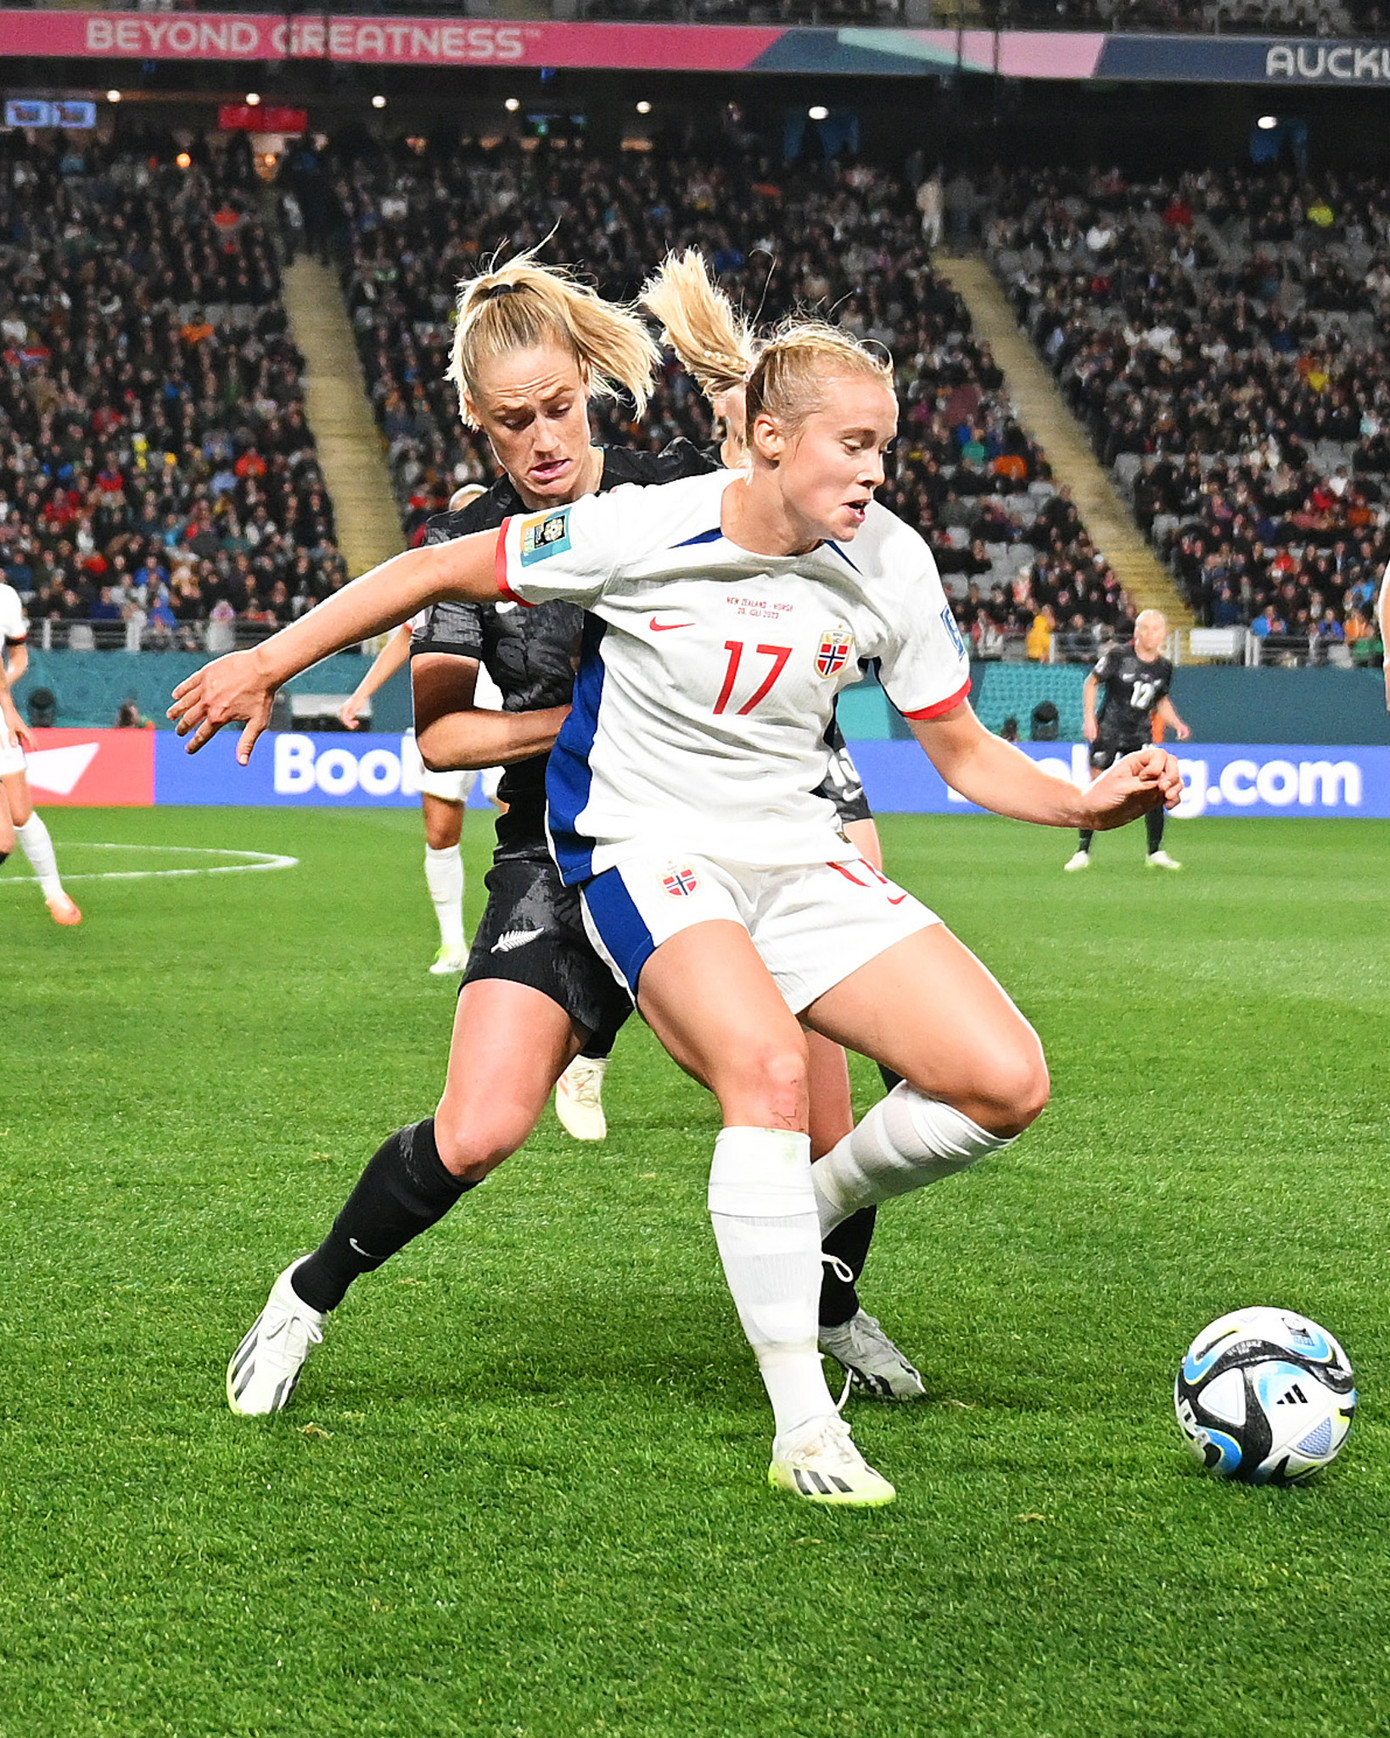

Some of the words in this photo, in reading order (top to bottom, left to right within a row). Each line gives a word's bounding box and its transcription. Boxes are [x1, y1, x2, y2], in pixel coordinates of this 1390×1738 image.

[86, 18, 259, 52] BEYOND
[712, 640, 793, 716] 17
[1130, 680, 1155, 710] 12
